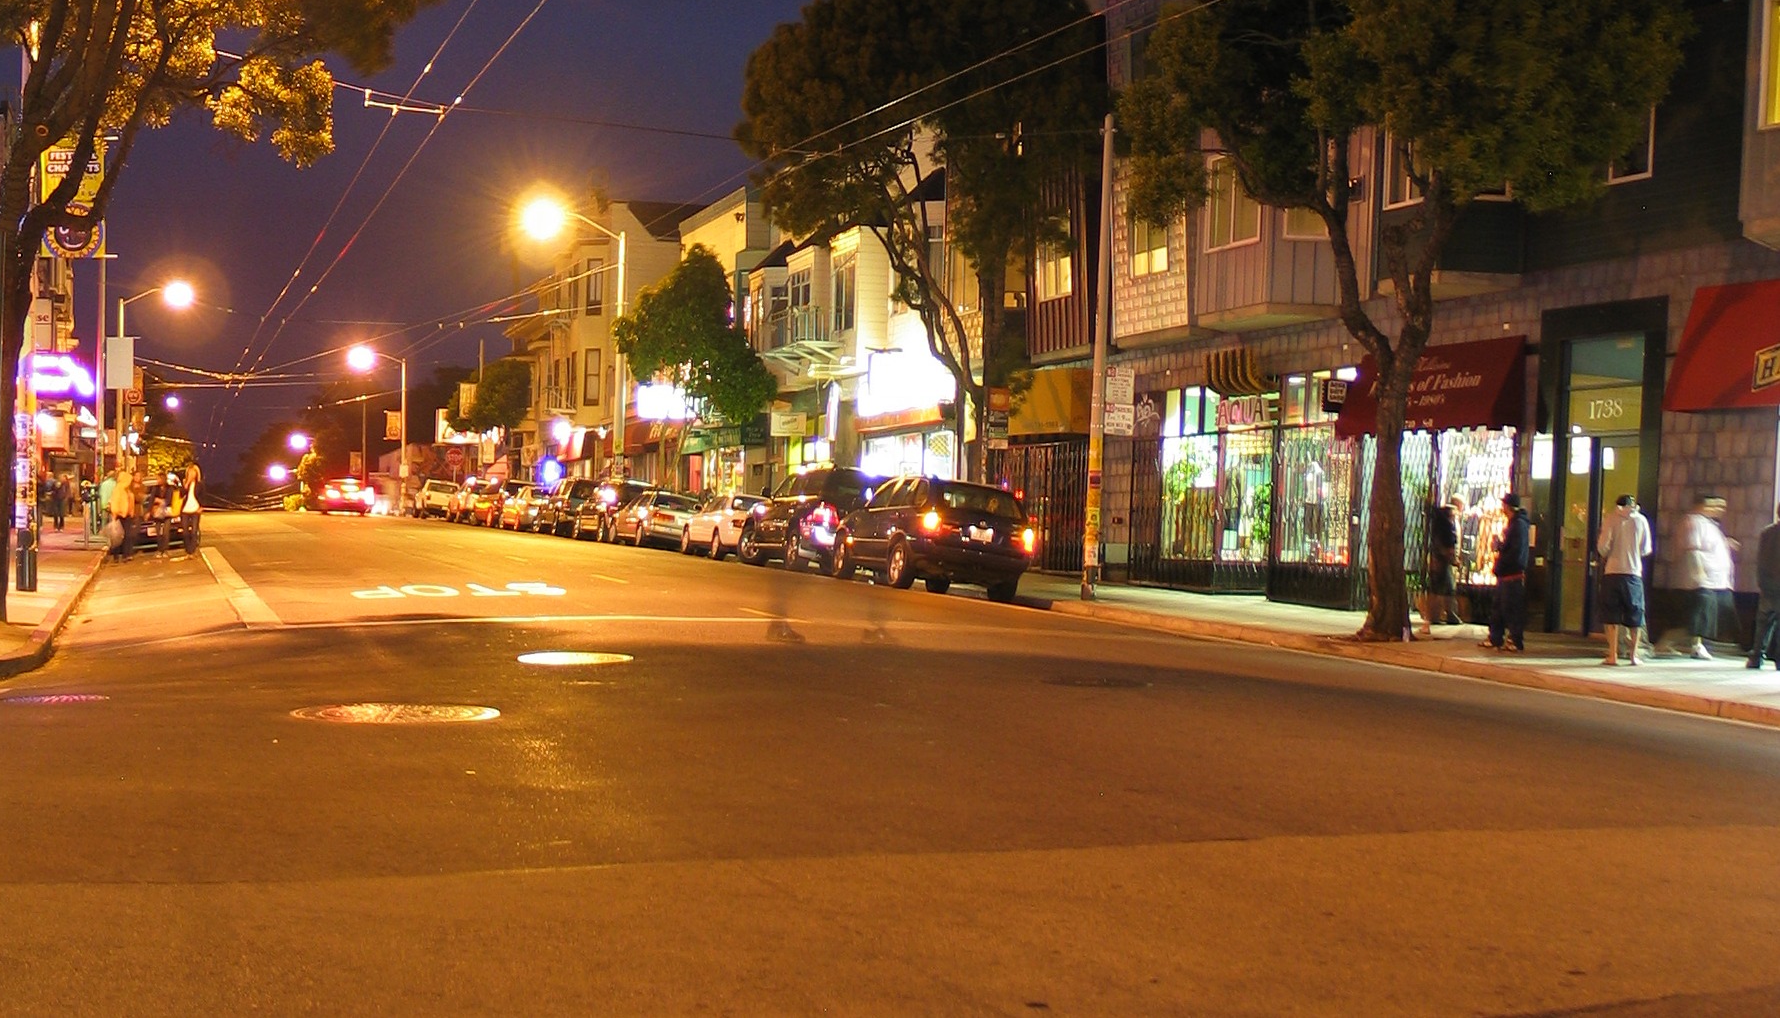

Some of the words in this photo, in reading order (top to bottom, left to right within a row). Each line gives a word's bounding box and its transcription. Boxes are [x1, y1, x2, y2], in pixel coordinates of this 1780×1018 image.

[1416, 376, 1433, 392] of
[1433, 370, 1482, 392] Fashion
[1589, 398, 1623, 420] 1738
[350, 582, 567, 600] STOP
